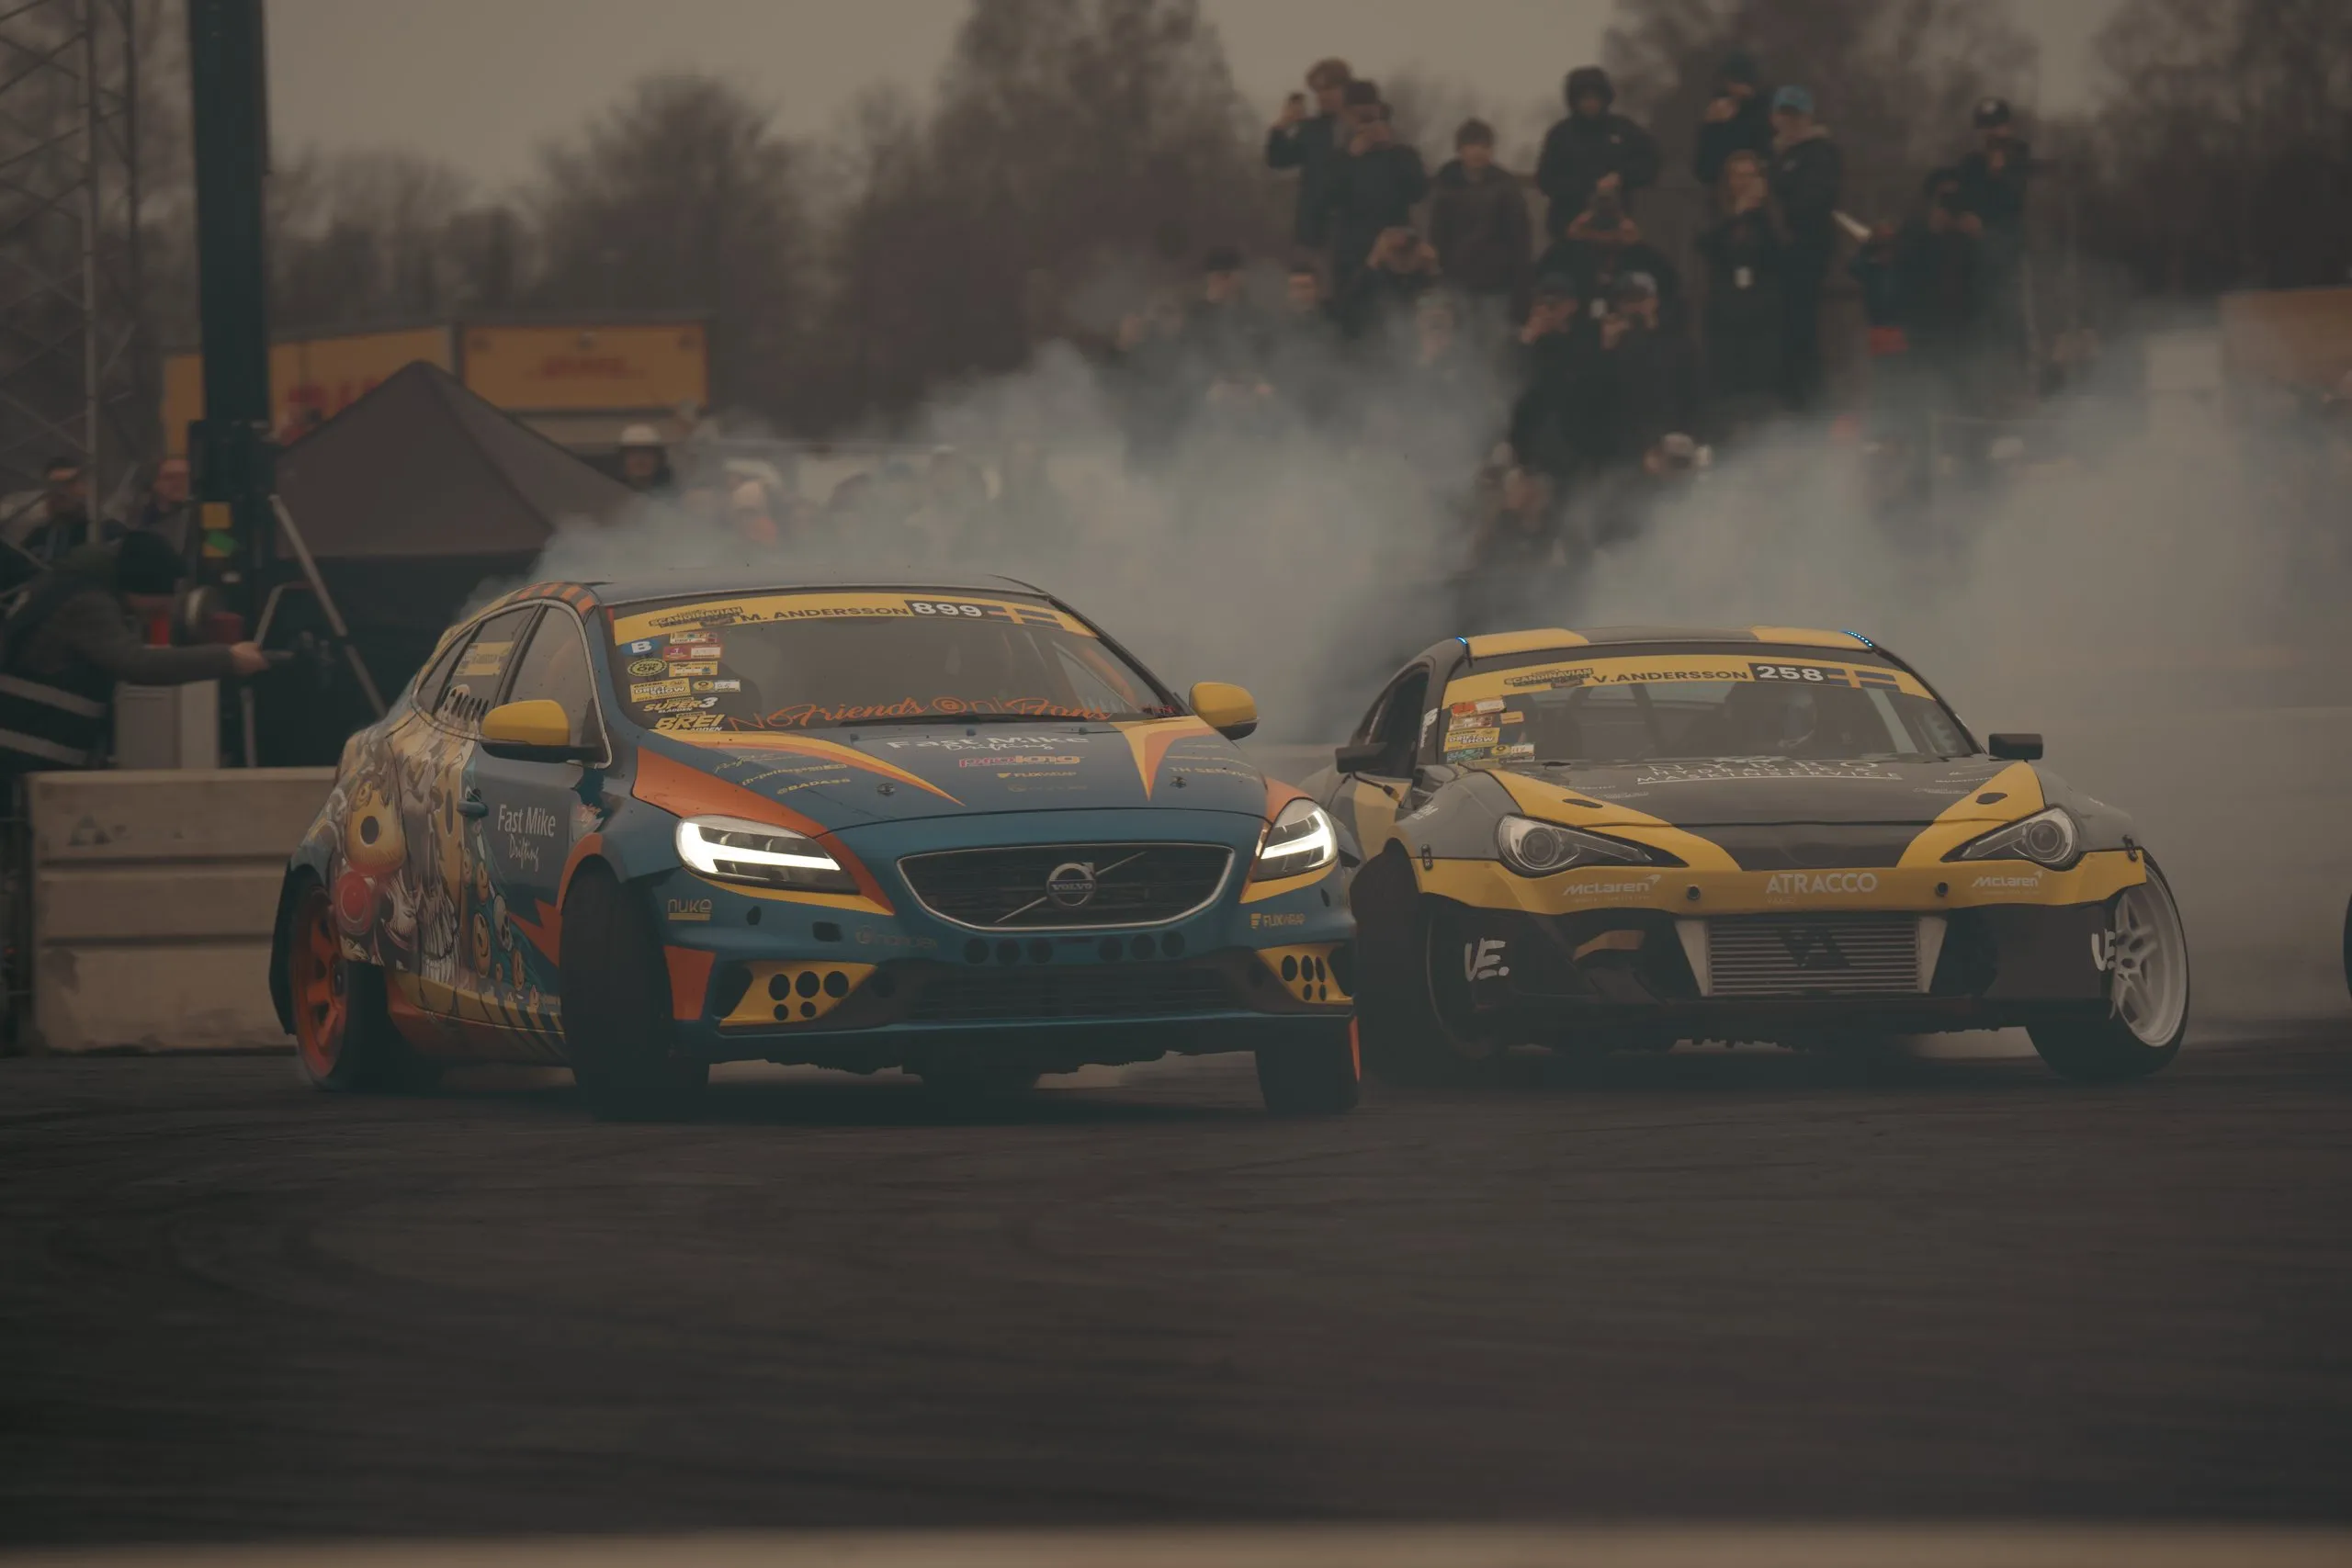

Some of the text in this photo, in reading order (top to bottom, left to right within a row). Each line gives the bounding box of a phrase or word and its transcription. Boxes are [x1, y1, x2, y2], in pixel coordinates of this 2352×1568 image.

[741, 607, 909, 623] M. ANDERSSON
[912, 602, 982, 617] 899
[631, 641, 652, 654] B
[1756, 665, 1825, 682] 258
[650, 687, 685, 695] SHOW
[655, 714, 726, 730] BREI
[887, 739, 978, 748] Fast
[1463, 736, 1494, 744] SHOW
[497, 804, 557, 838] Fast Mike
[509, 833, 539, 873] Drifting
[1050, 883, 1093, 891] VOLVO
[1765, 873, 1879, 894] ATRACCO
[1972, 876, 2039, 887] McLaren
[1562, 882, 1650, 896] McLaren
